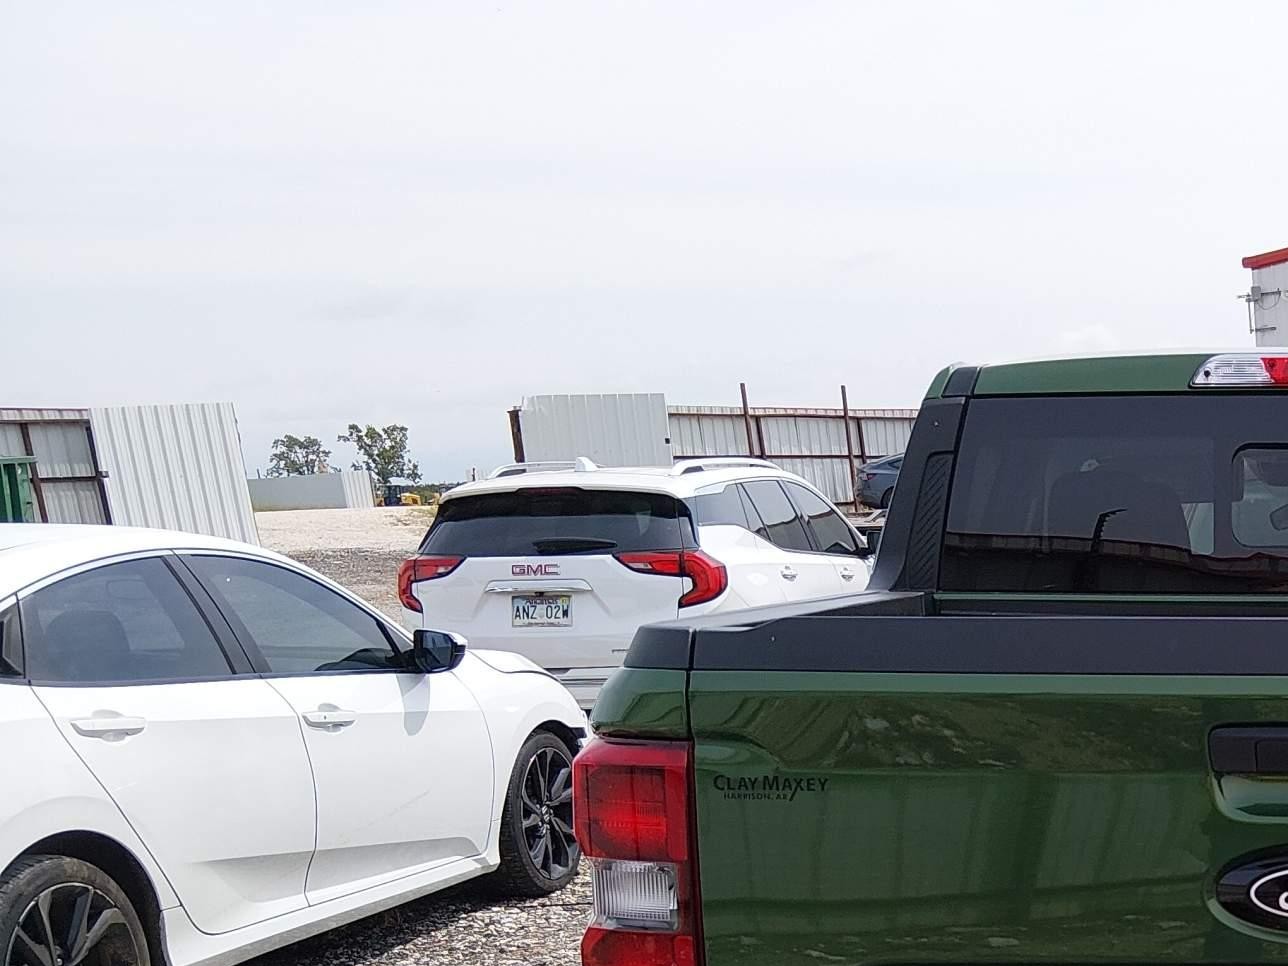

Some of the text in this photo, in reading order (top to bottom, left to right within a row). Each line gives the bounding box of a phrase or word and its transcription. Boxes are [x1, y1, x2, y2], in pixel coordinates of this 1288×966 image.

[511, 564, 560, 576] GMC
[514, 604, 569, 620] ANZ 02W
[713, 774, 829, 801] CLAY MAXEY
